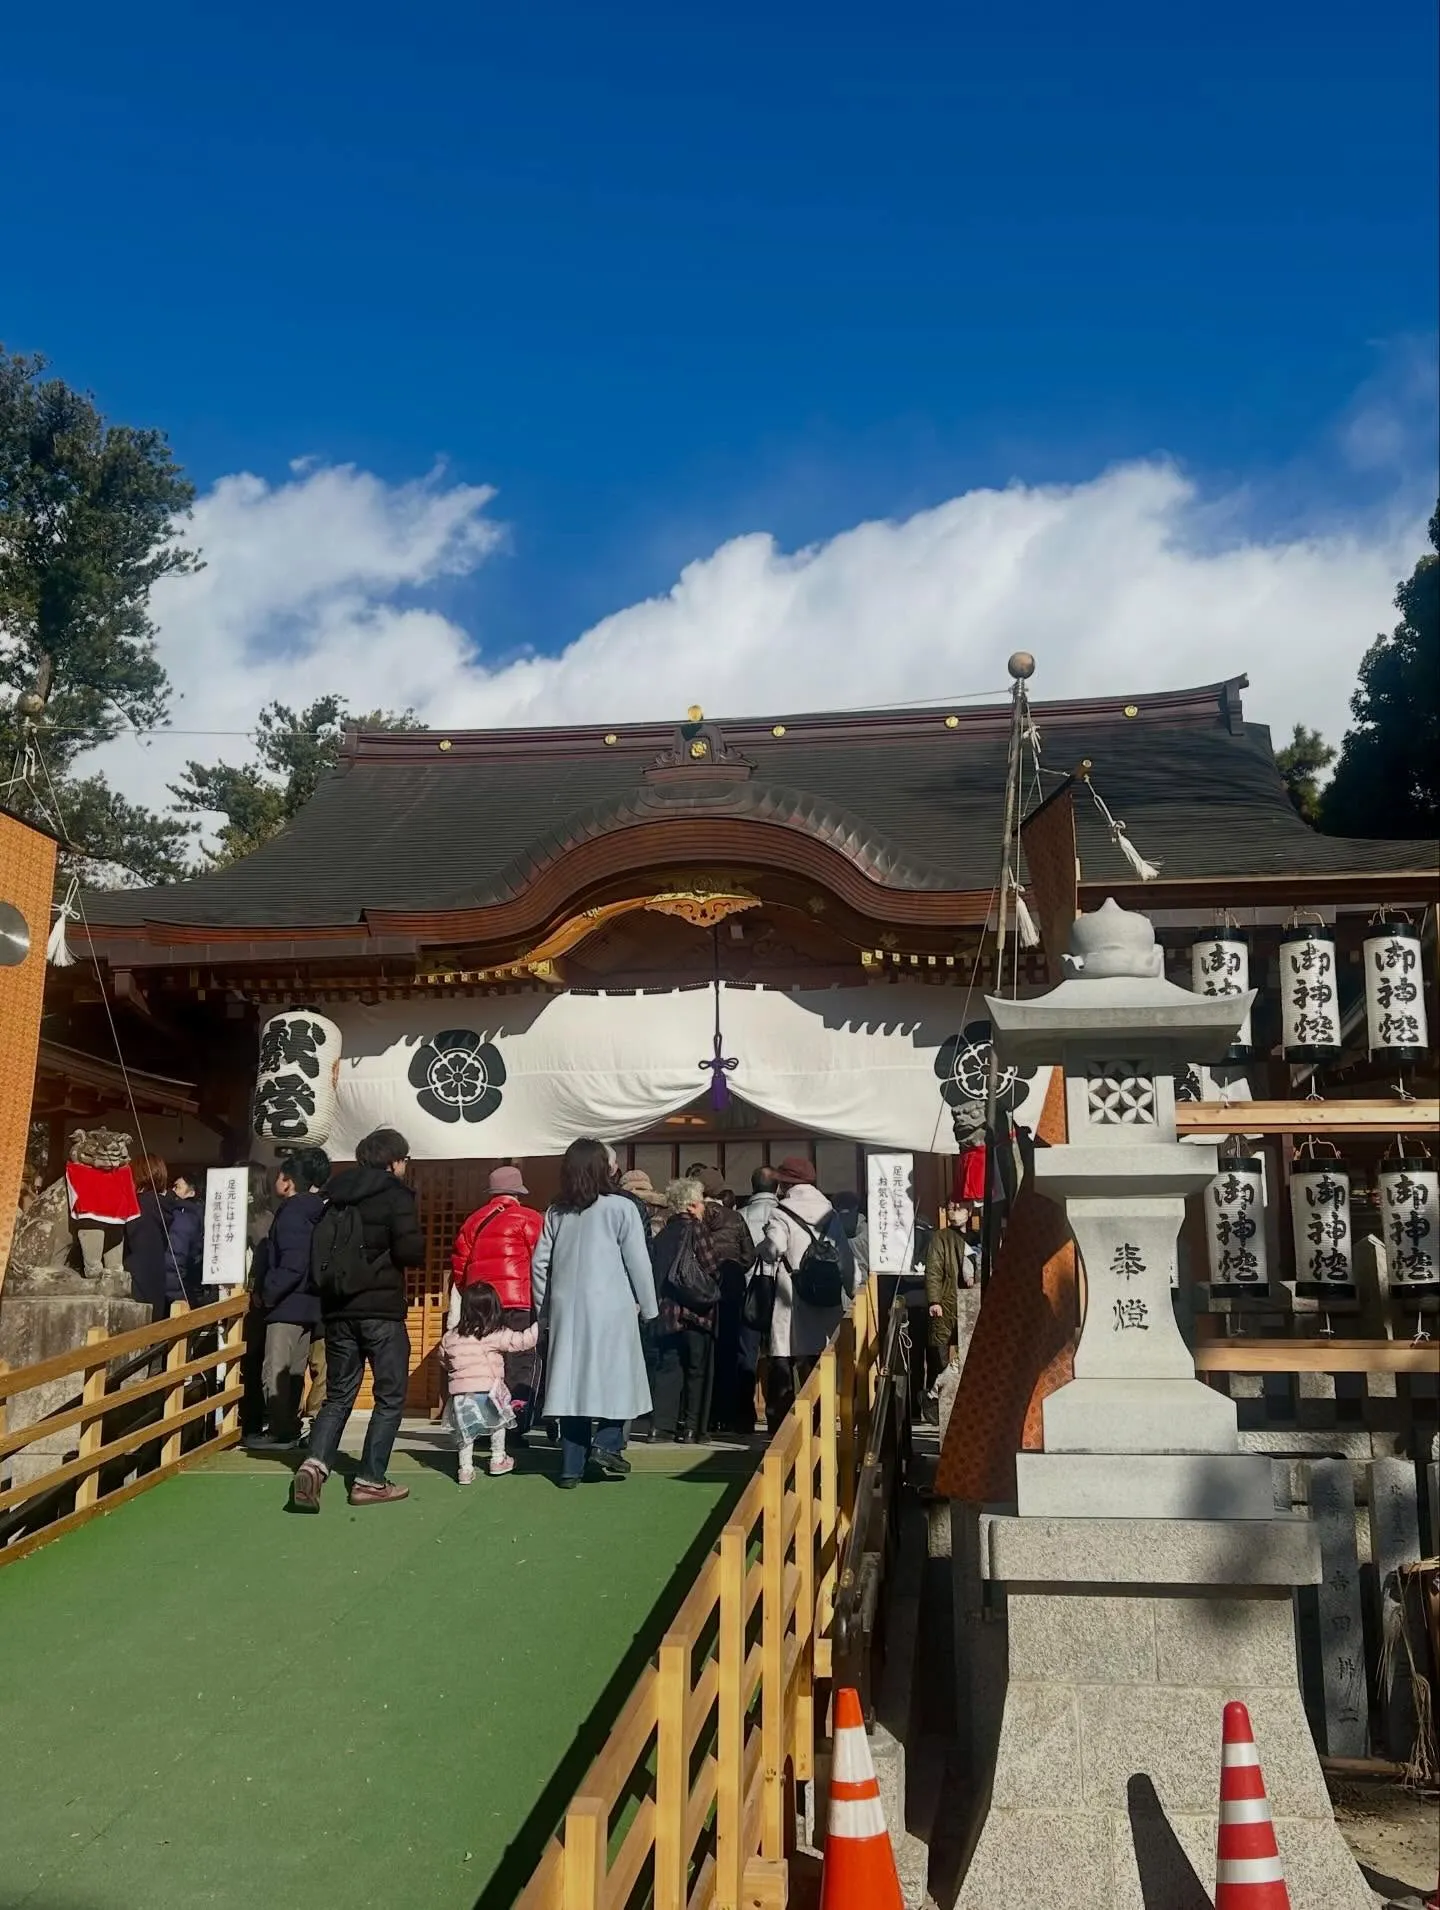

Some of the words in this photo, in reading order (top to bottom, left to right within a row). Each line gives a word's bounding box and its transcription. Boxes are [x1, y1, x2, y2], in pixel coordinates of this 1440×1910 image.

[210, 1191, 222, 1274] お気を付け下さい
[224, 1178, 238, 1243] 足元には十分
[1109, 1242, 1149, 1333] 奉燈
